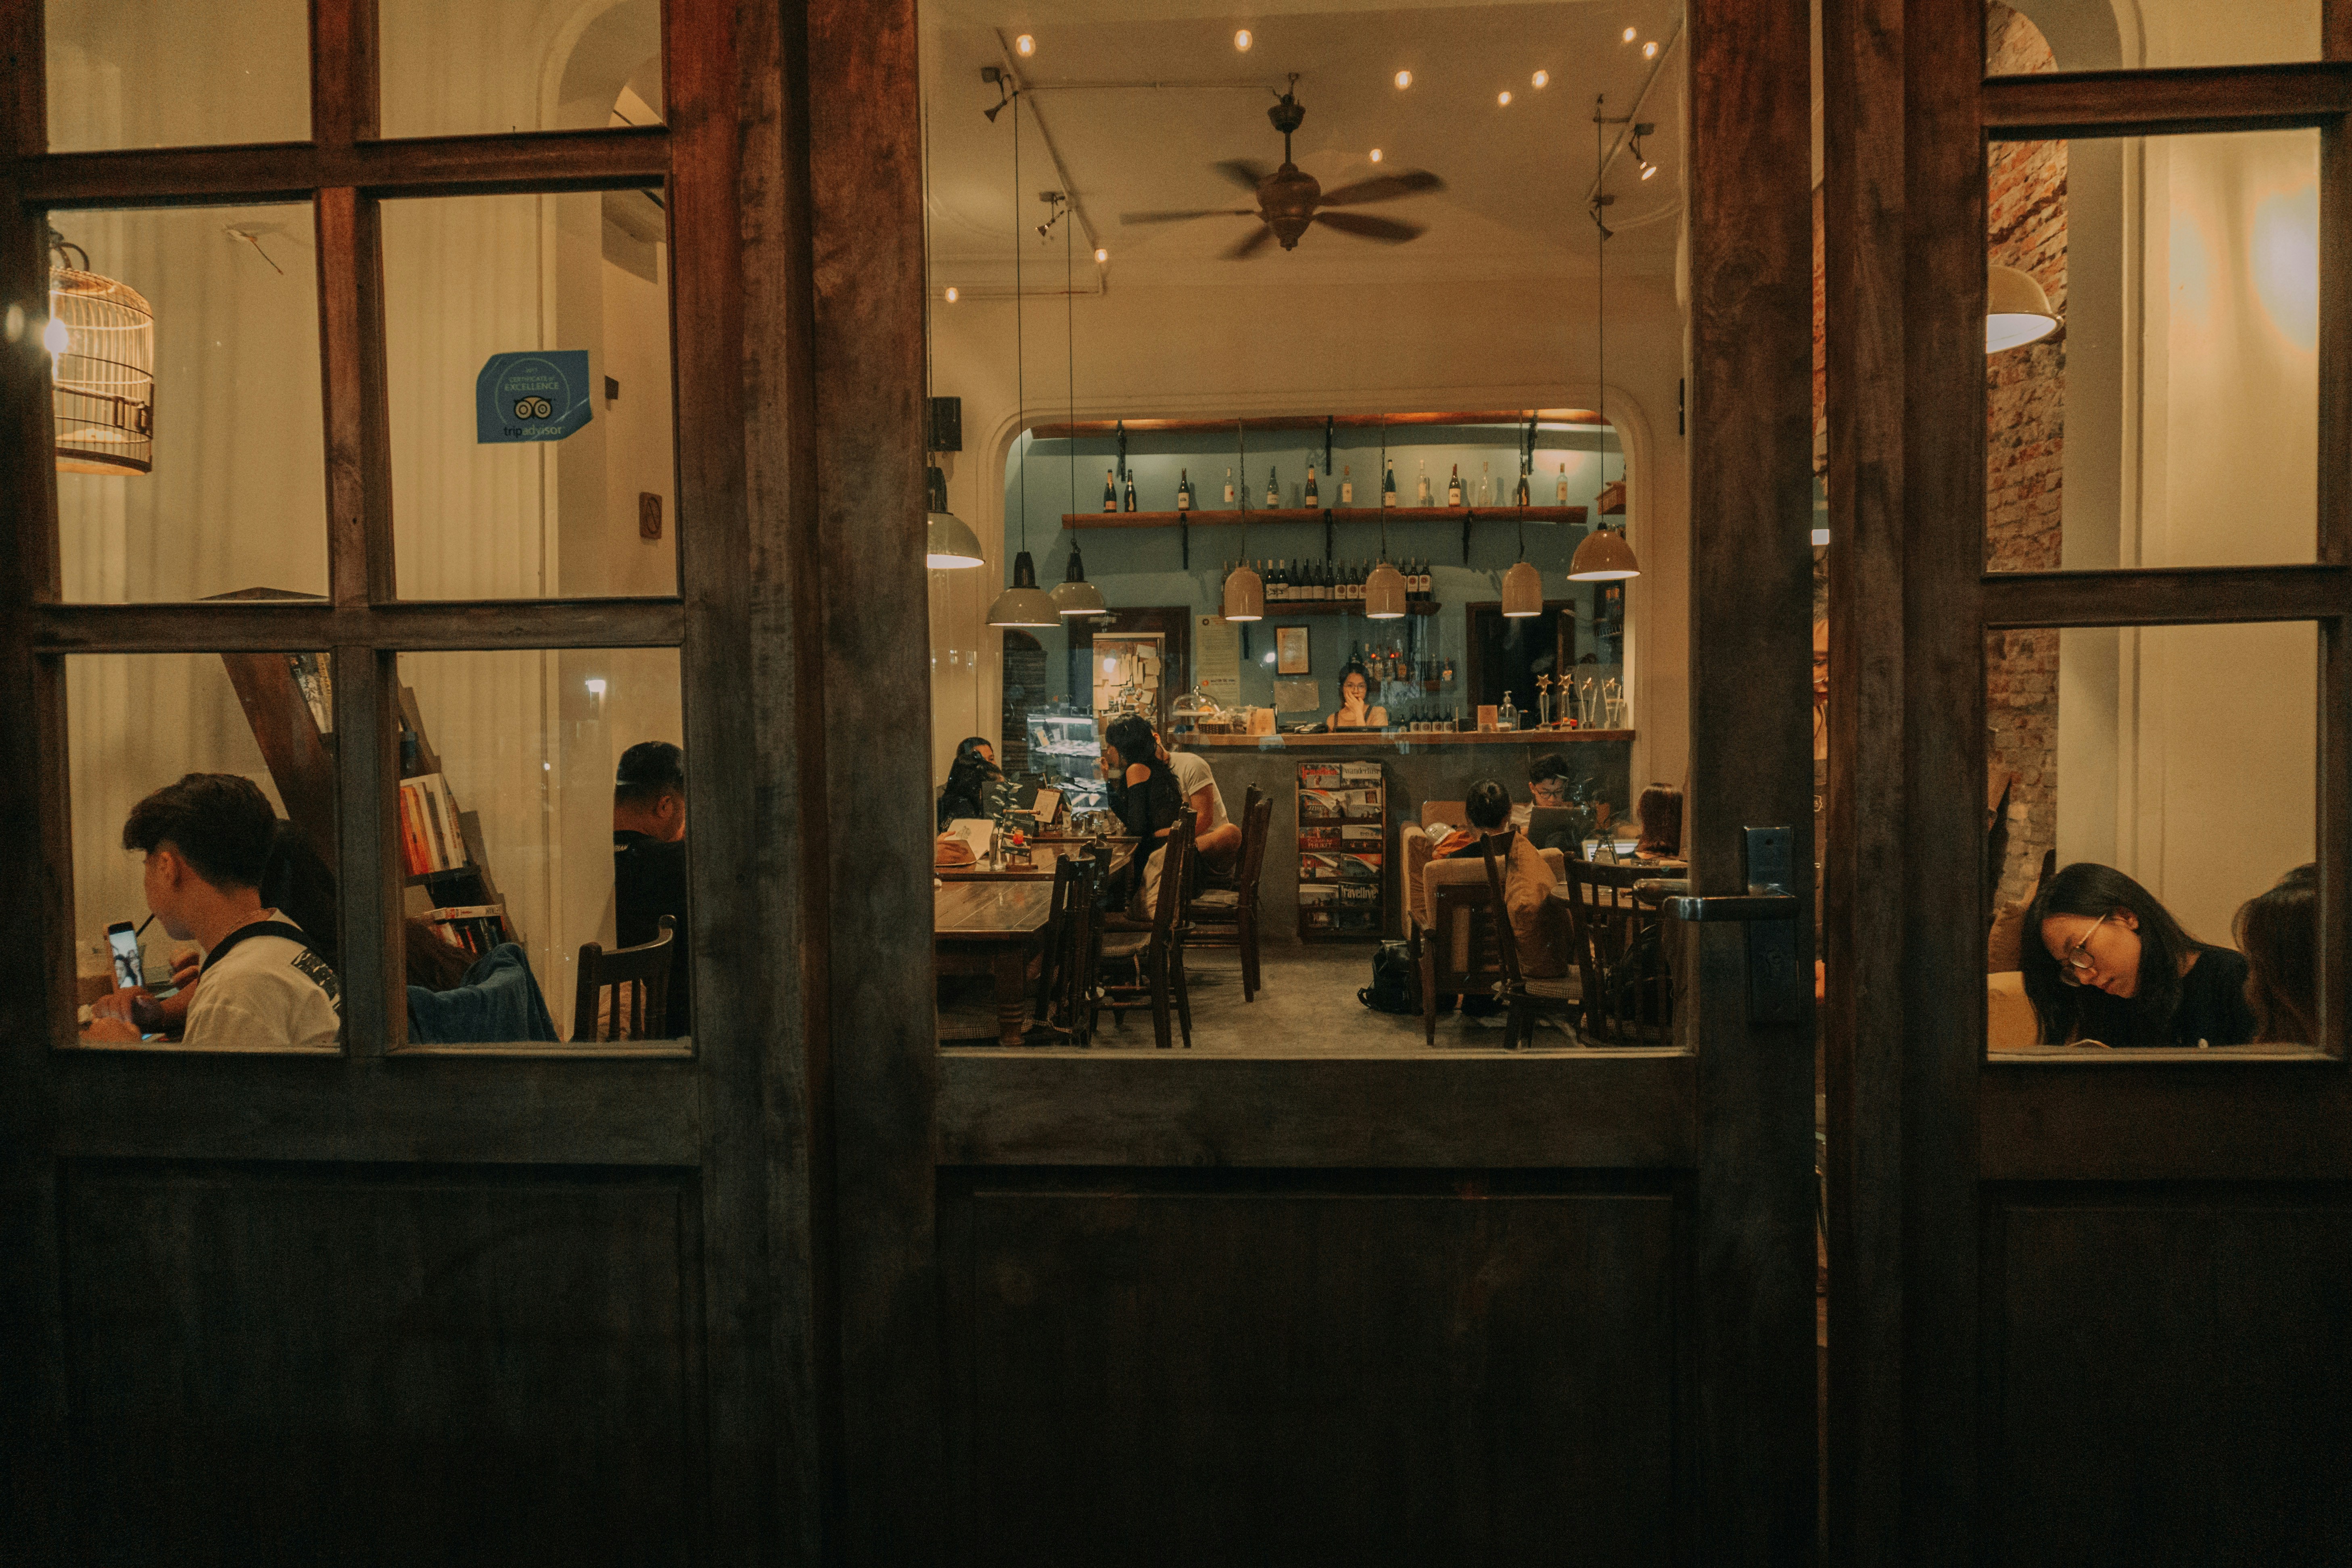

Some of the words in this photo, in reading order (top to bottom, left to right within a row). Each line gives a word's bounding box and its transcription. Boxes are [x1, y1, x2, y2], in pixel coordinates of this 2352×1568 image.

[504, 382, 559, 391] EXCELLENCE
[503, 424, 562, 438] tripadvisor
[1340, 885, 1377, 899] Travellive
